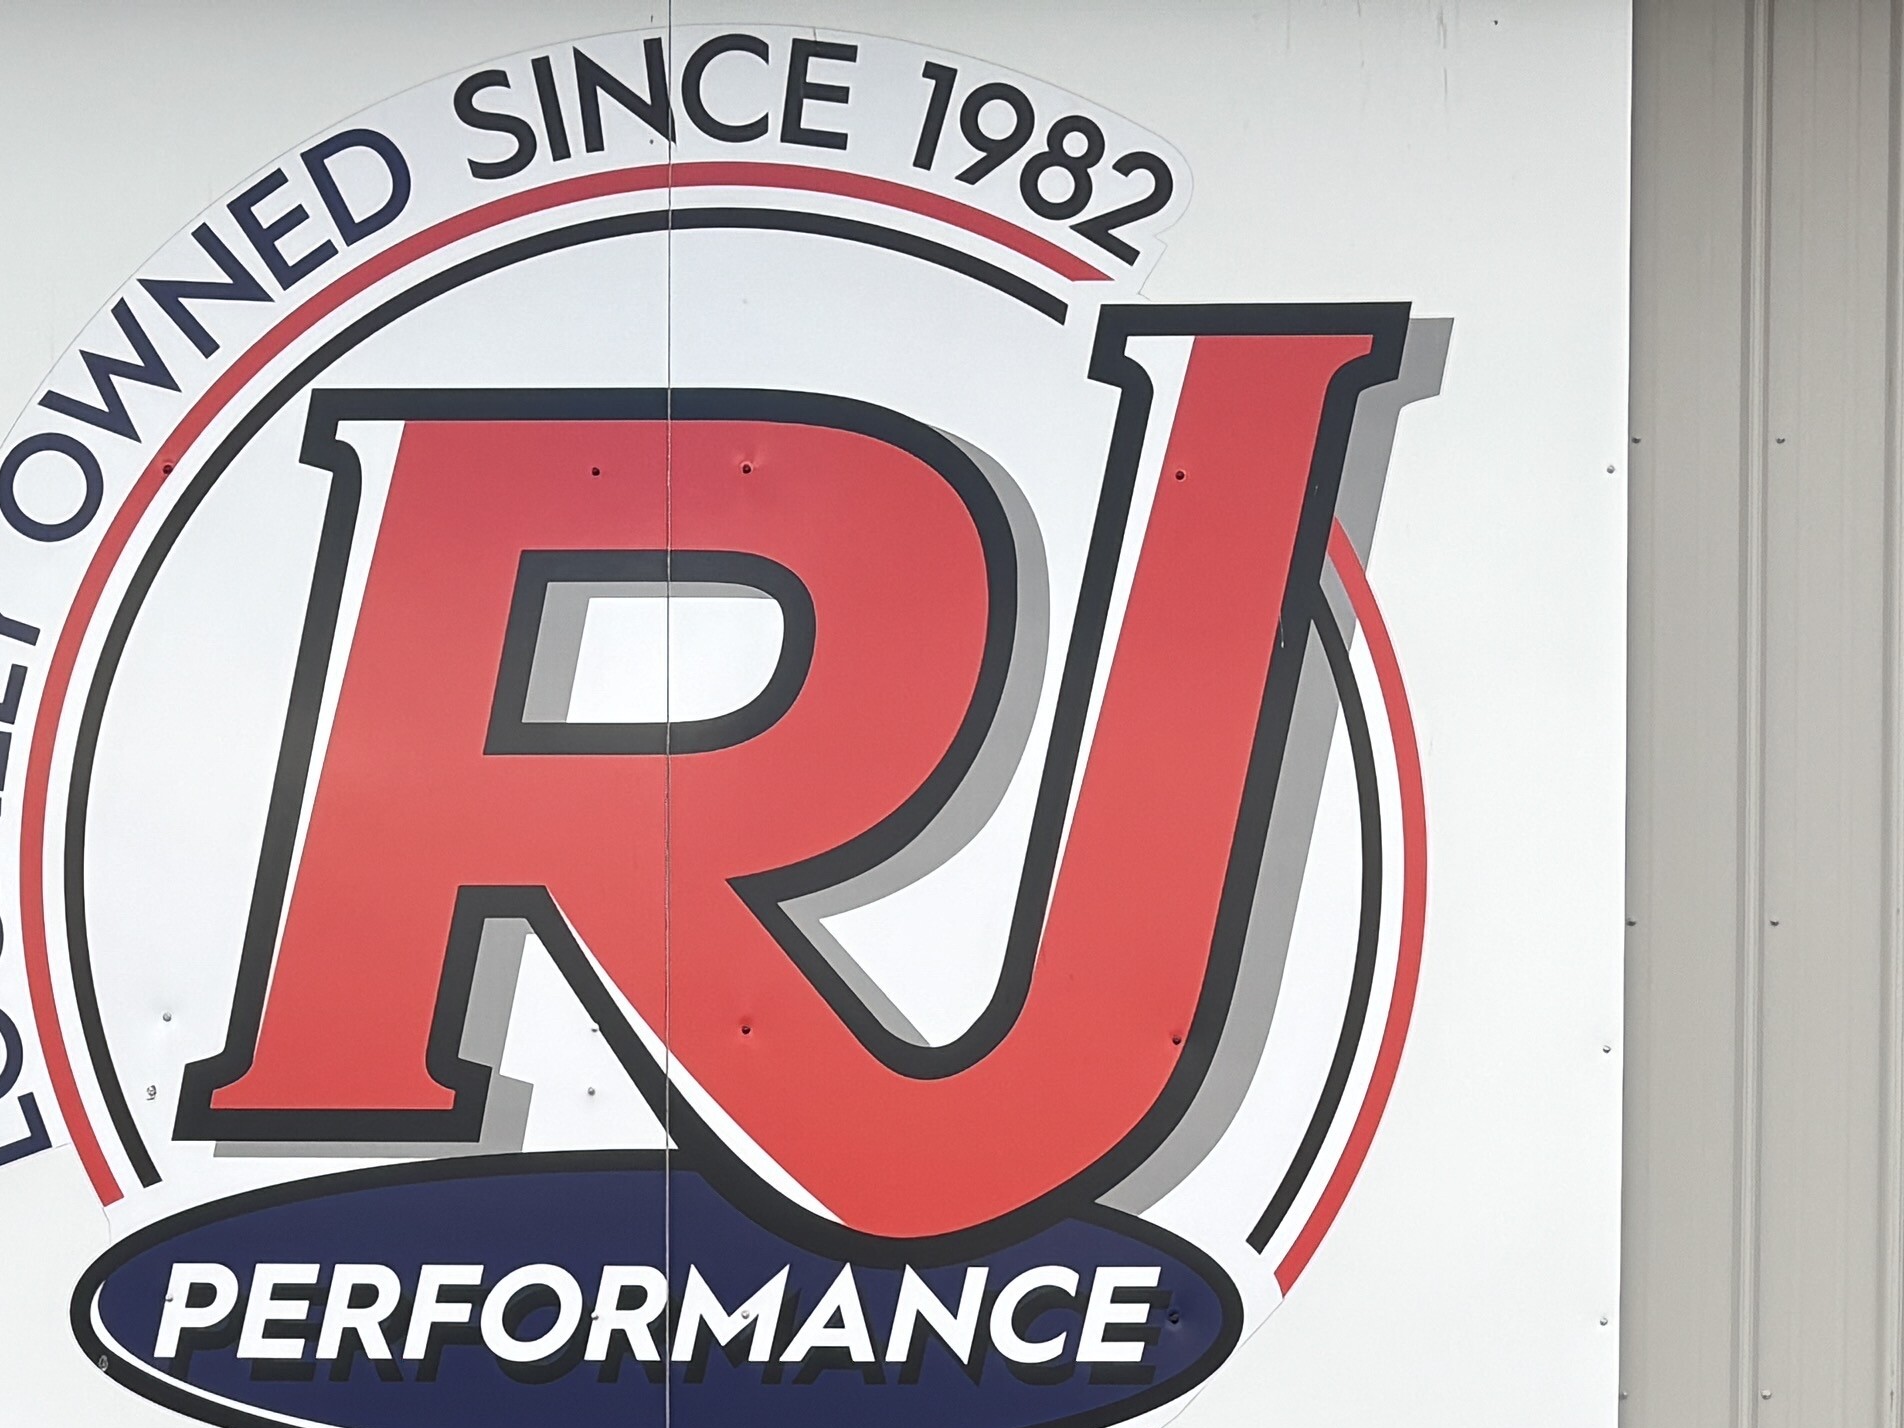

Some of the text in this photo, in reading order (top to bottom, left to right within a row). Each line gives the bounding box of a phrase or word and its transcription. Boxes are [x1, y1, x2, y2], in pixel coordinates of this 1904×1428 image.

[454, 34, 858, 180] SINCE
[913, 61, 1173, 267] 1982
[172, 301, 1413, 1267] RJ
[154, 1262, 1162, 1364] PERFORMANCE
